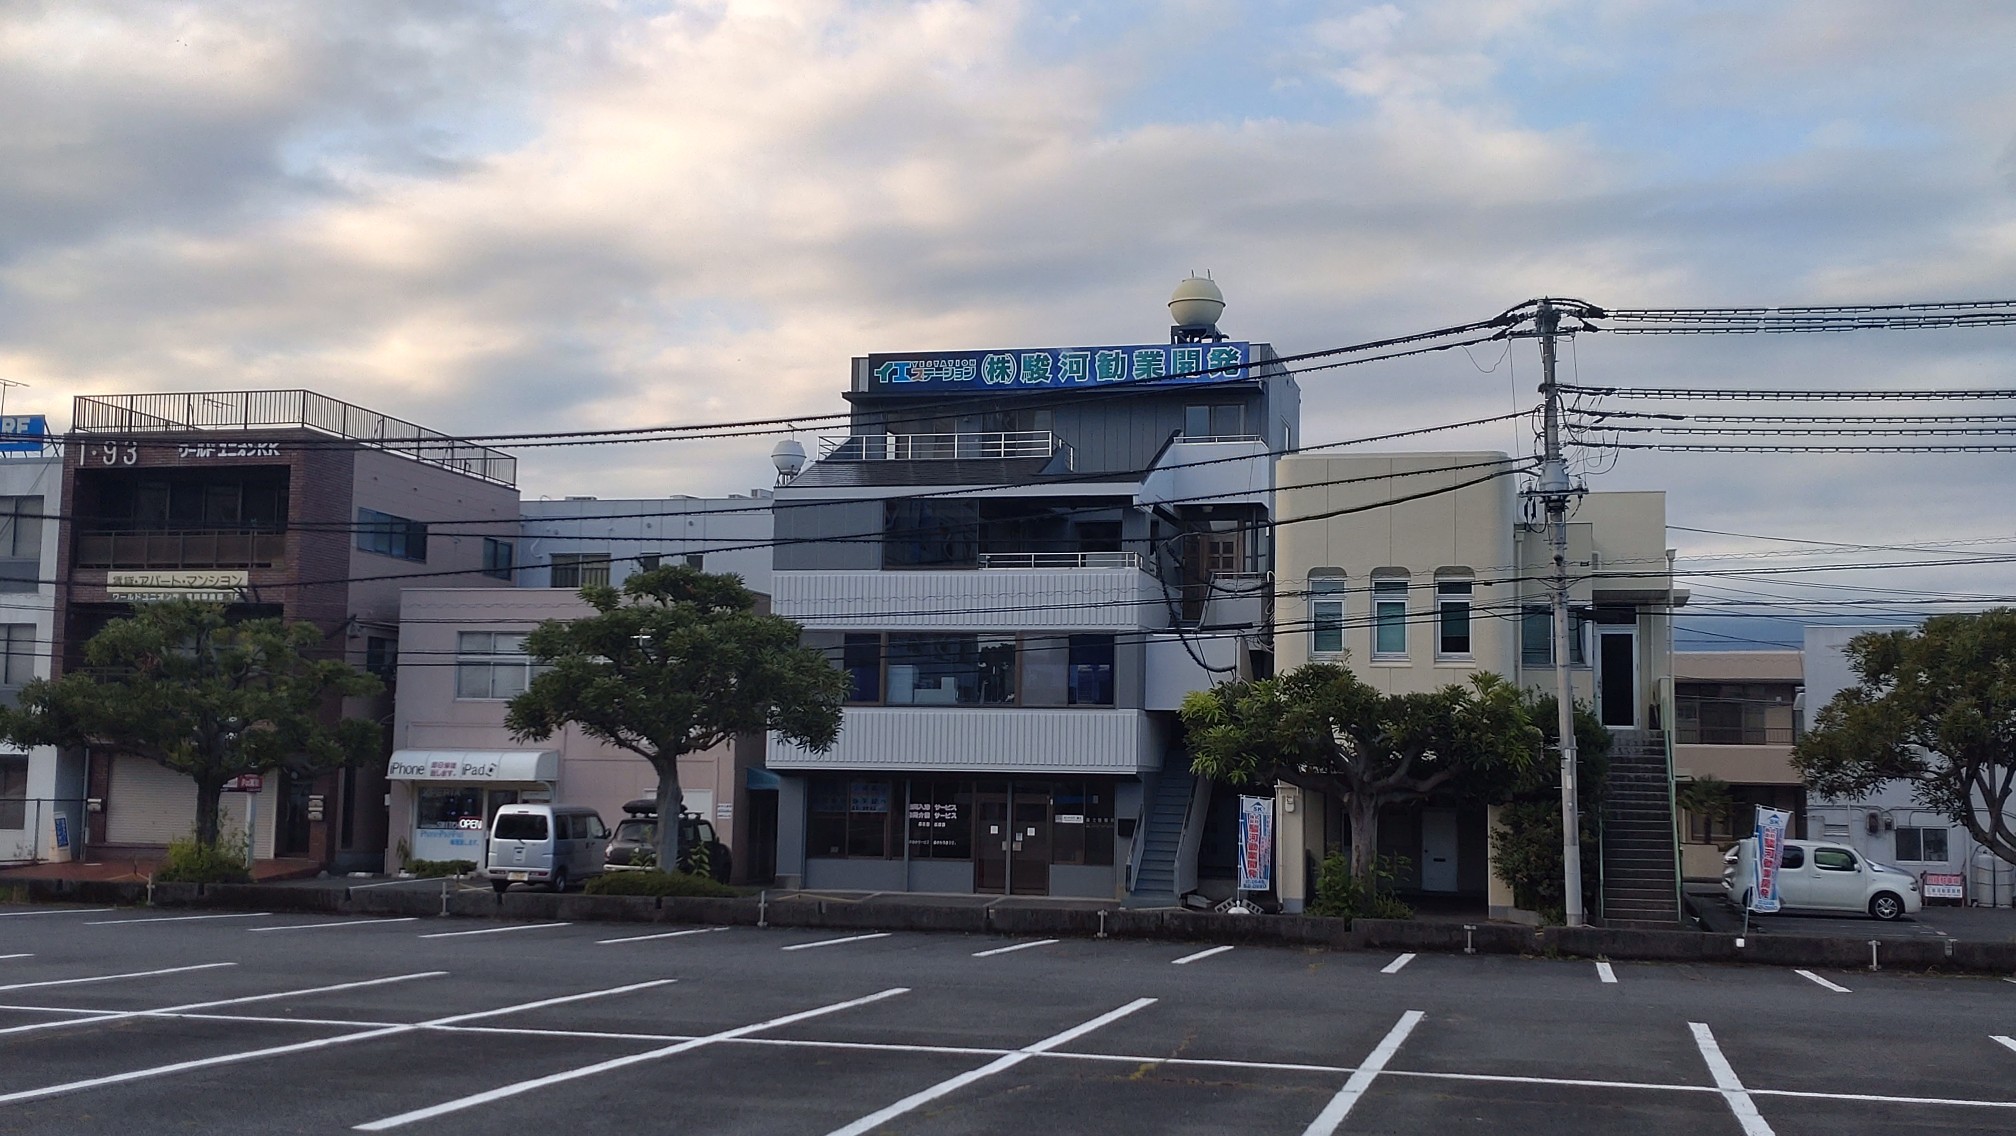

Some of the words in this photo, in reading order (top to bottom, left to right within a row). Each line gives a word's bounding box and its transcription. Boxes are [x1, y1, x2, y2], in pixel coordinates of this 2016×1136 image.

[390, 762, 425, 775] iPhone
[462, 763, 486, 776] iPad
[934, 803, 957, 811] サービス
[934, 811, 957, 819] サービス
[459, 818, 482, 829] OPEN
